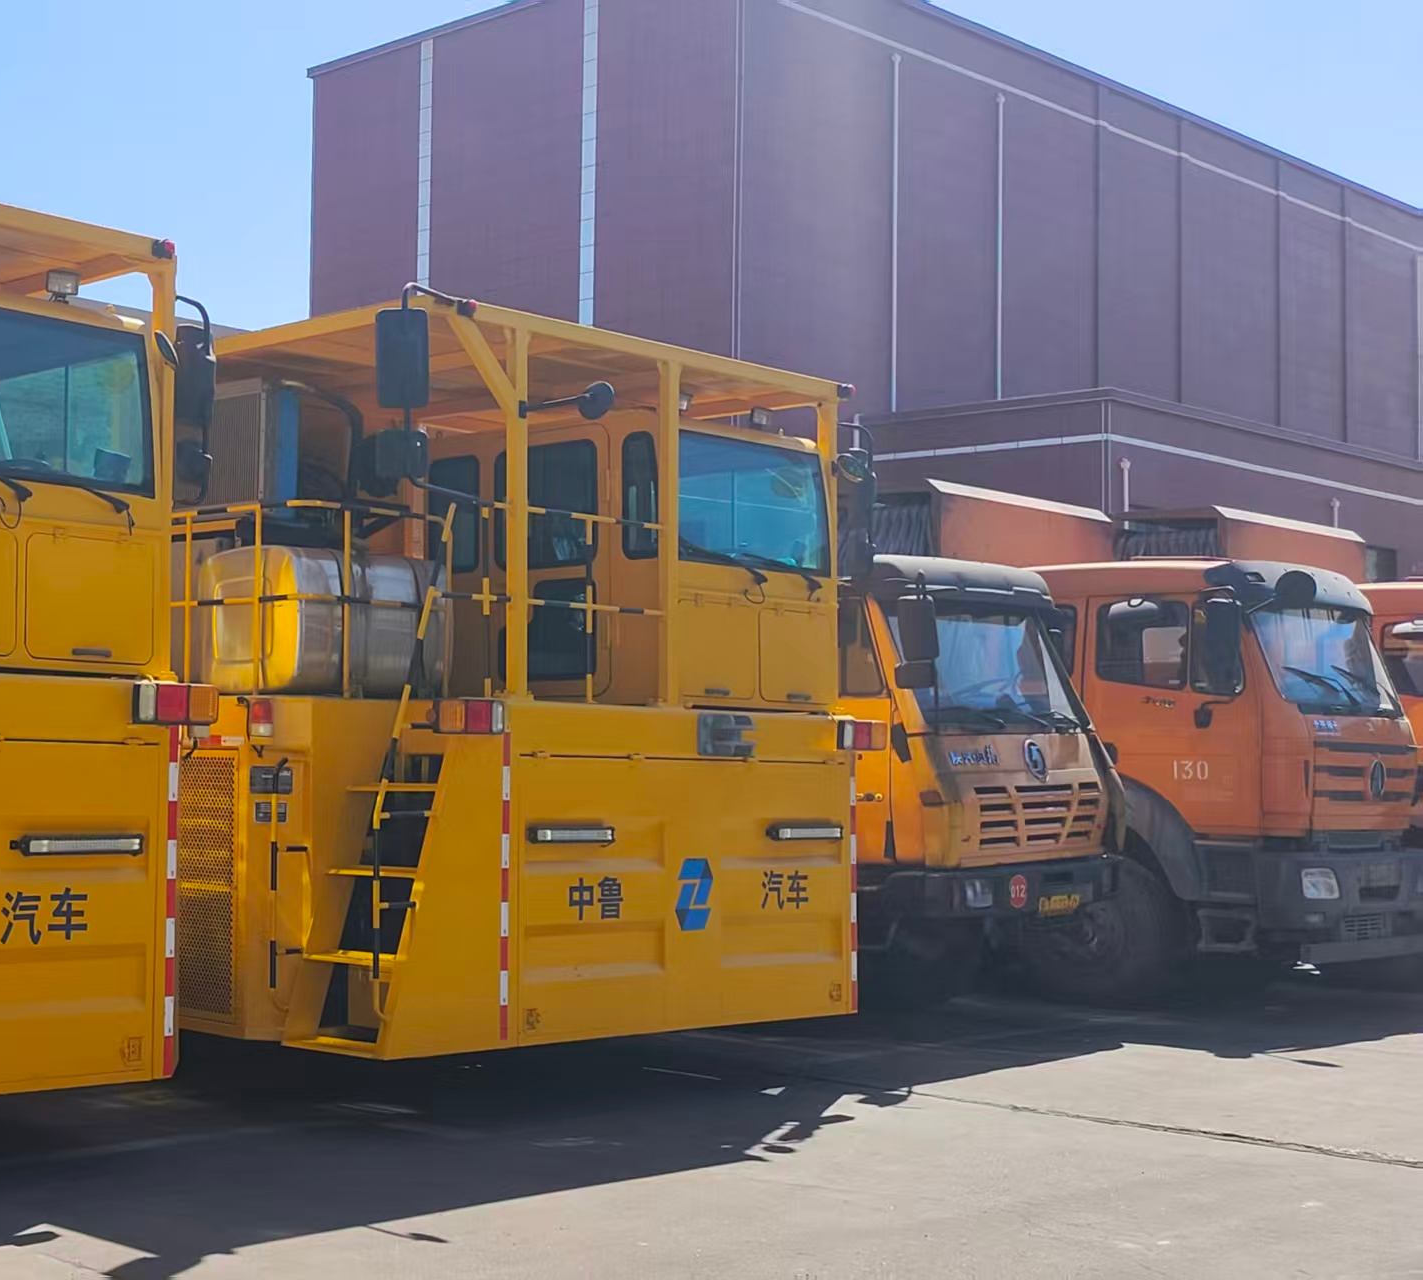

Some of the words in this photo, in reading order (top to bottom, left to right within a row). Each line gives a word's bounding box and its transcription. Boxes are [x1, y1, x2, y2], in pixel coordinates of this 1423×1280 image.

[1173, 759, 1209, 781] 130
[0, 887, 88, 945] 汽车
[568, 876, 624, 921] 中鲁
[761, 870, 809, 910] 汽车
